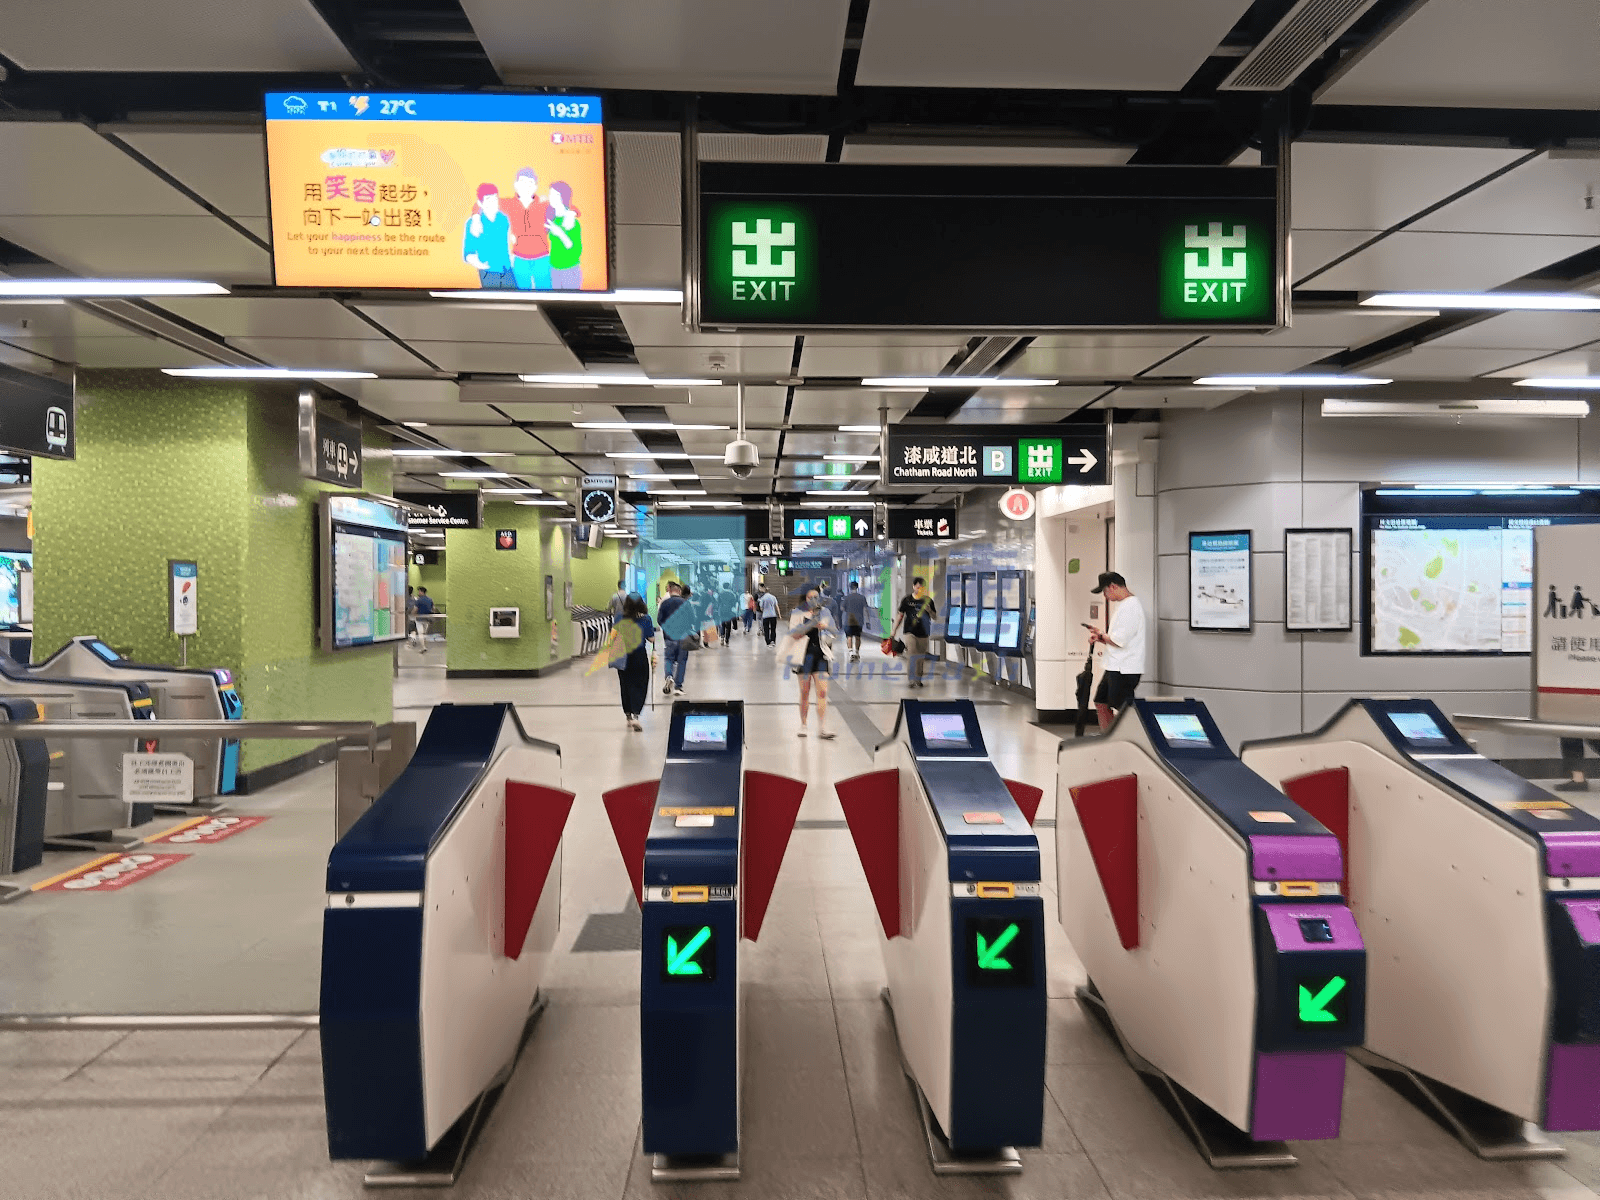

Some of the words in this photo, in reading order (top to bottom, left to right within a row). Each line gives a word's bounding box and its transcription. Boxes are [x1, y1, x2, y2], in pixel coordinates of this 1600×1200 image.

[380, 99, 417, 115] 27°C
[547, 102, 590, 118] 19:37
[287, 232, 303, 241] Let
[306, 233, 329, 242] your
[331, 232, 382, 243] happiness
[384, 232, 397, 242] be
[399, 232, 416, 242] the
[418, 234, 446, 243] route
[308, 246, 319, 255] to
[321, 247, 344, 257] your
[346, 247, 370, 256] next
[371, 246, 429, 256] destination
[732, 280, 796, 301] EXIT
[1183, 282, 1247, 303] EXIT
[991, 450, 1005, 472] B
[893, 467, 931, 477] Chatham
[932, 467, 953, 477] Road
[953, 467, 978, 477] North
